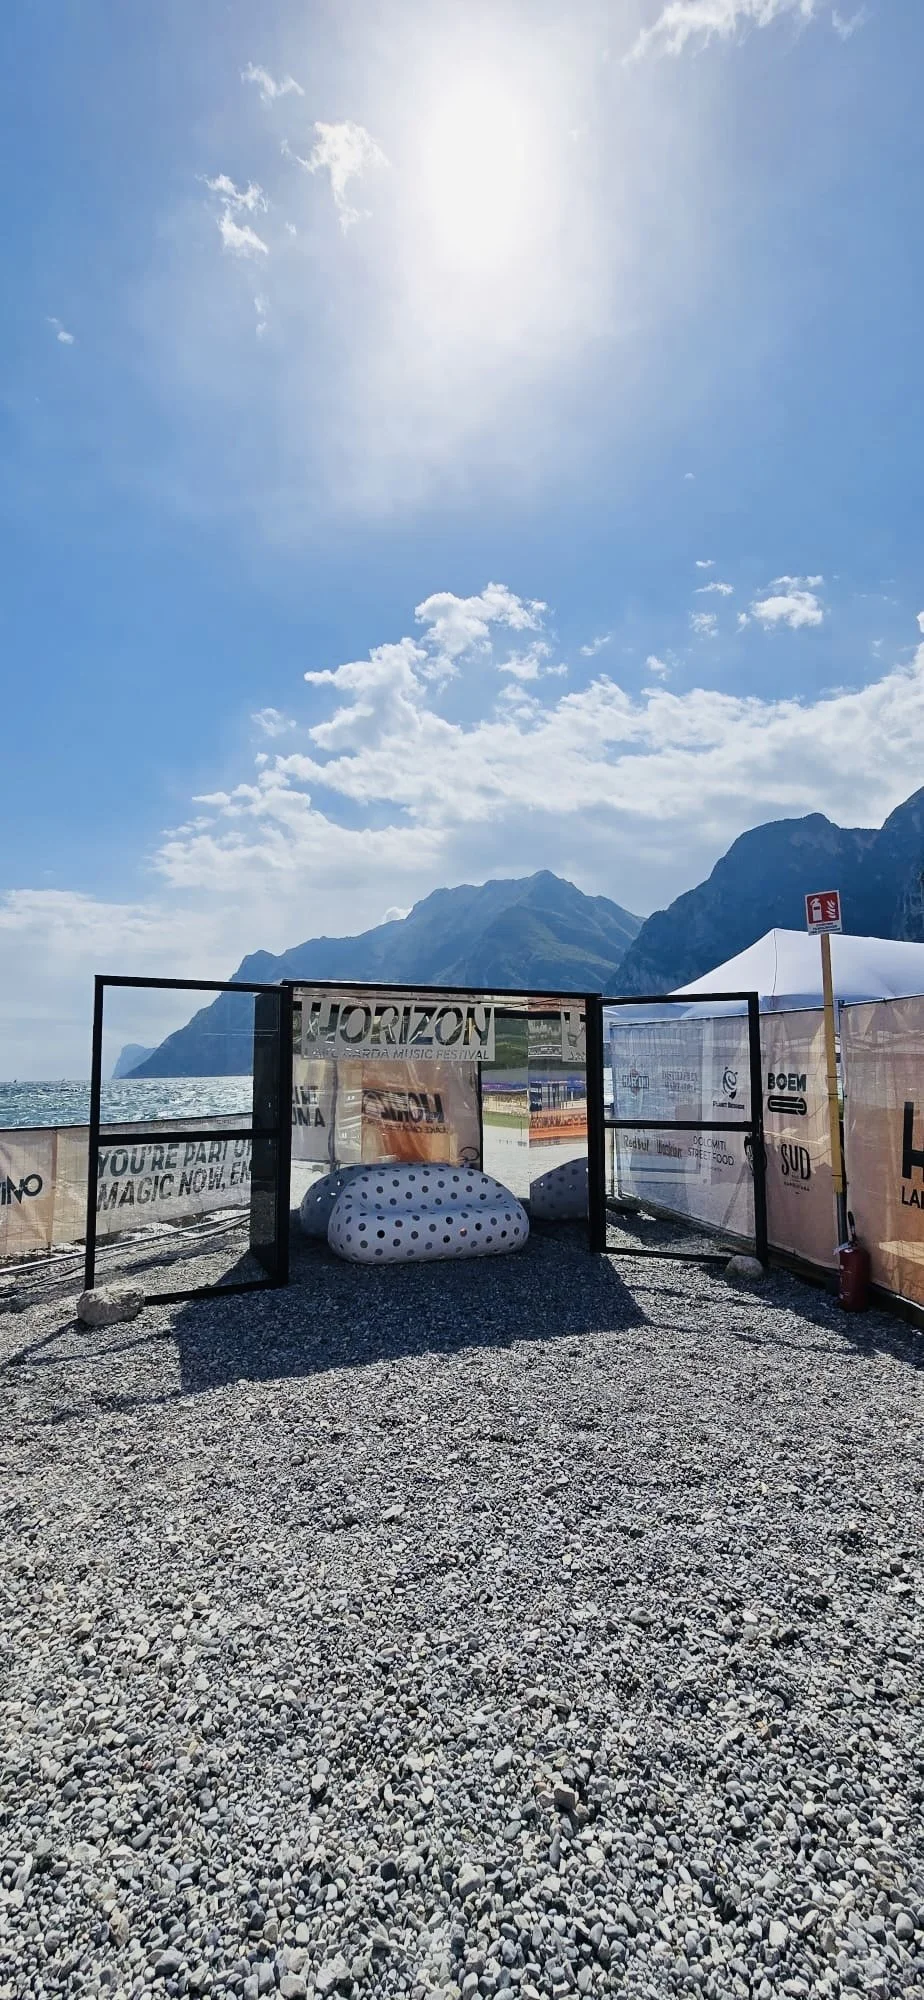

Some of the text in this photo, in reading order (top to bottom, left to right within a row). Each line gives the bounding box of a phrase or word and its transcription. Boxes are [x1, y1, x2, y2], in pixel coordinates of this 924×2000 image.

[306, 1001, 492, 1046] HORIZON
[393, 1049, 434, 1060] MUSIC
[436, 1049, 489, 1060] FESTIVAL
[693, 1135, 727, 1152] DOLOMITI
[98, 1143, 180, 1179] YOU'RE
[712, 1152, 735, 1166] FOOD
[781, 1143, 811, 1180] SUD
[96, 1173, 175, 1212] MAGIC
[178, 1165, 226, 1196] NOW,
[902, 1185, 924, 1210] LA
